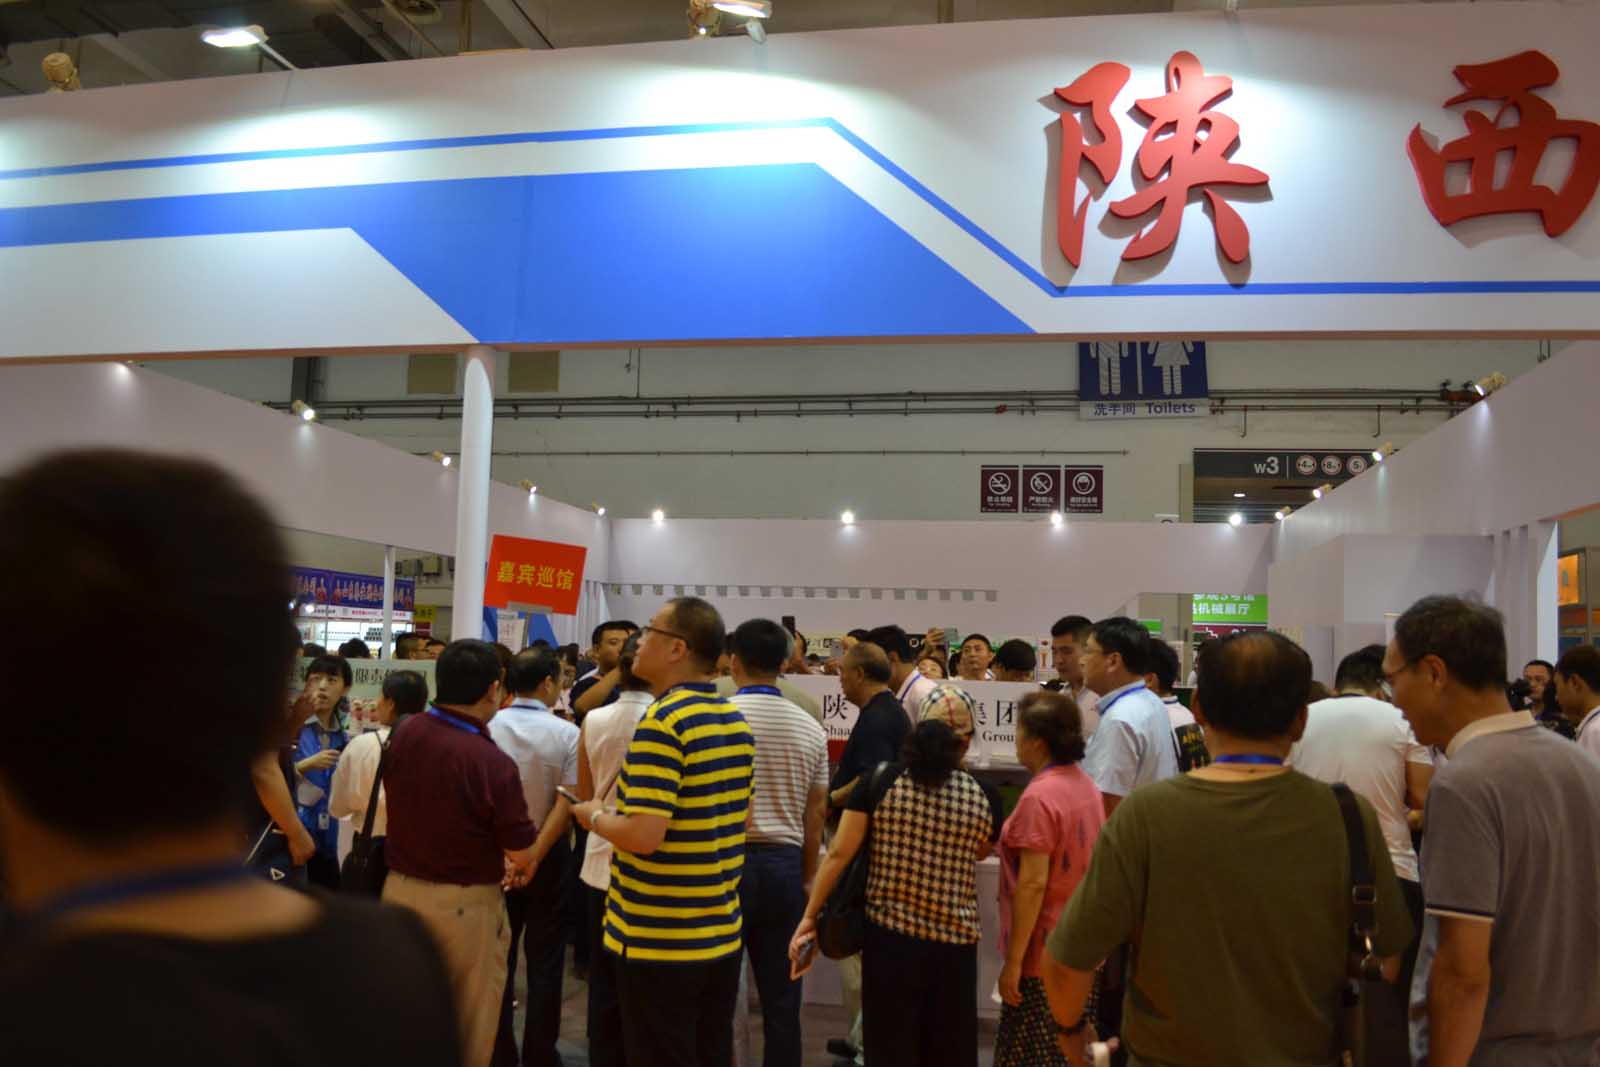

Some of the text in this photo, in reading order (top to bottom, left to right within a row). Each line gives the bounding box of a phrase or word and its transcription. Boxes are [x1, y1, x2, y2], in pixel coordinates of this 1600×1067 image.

[1094, 402, 1136, 416] 洗手间
[1144, 401, 1195, 415] Toilets
[496, 560, 576, 591] 嘉宾巡馆
[823, 694, 848, 720] 陕
[982, 730, 1015, 743] Grou
